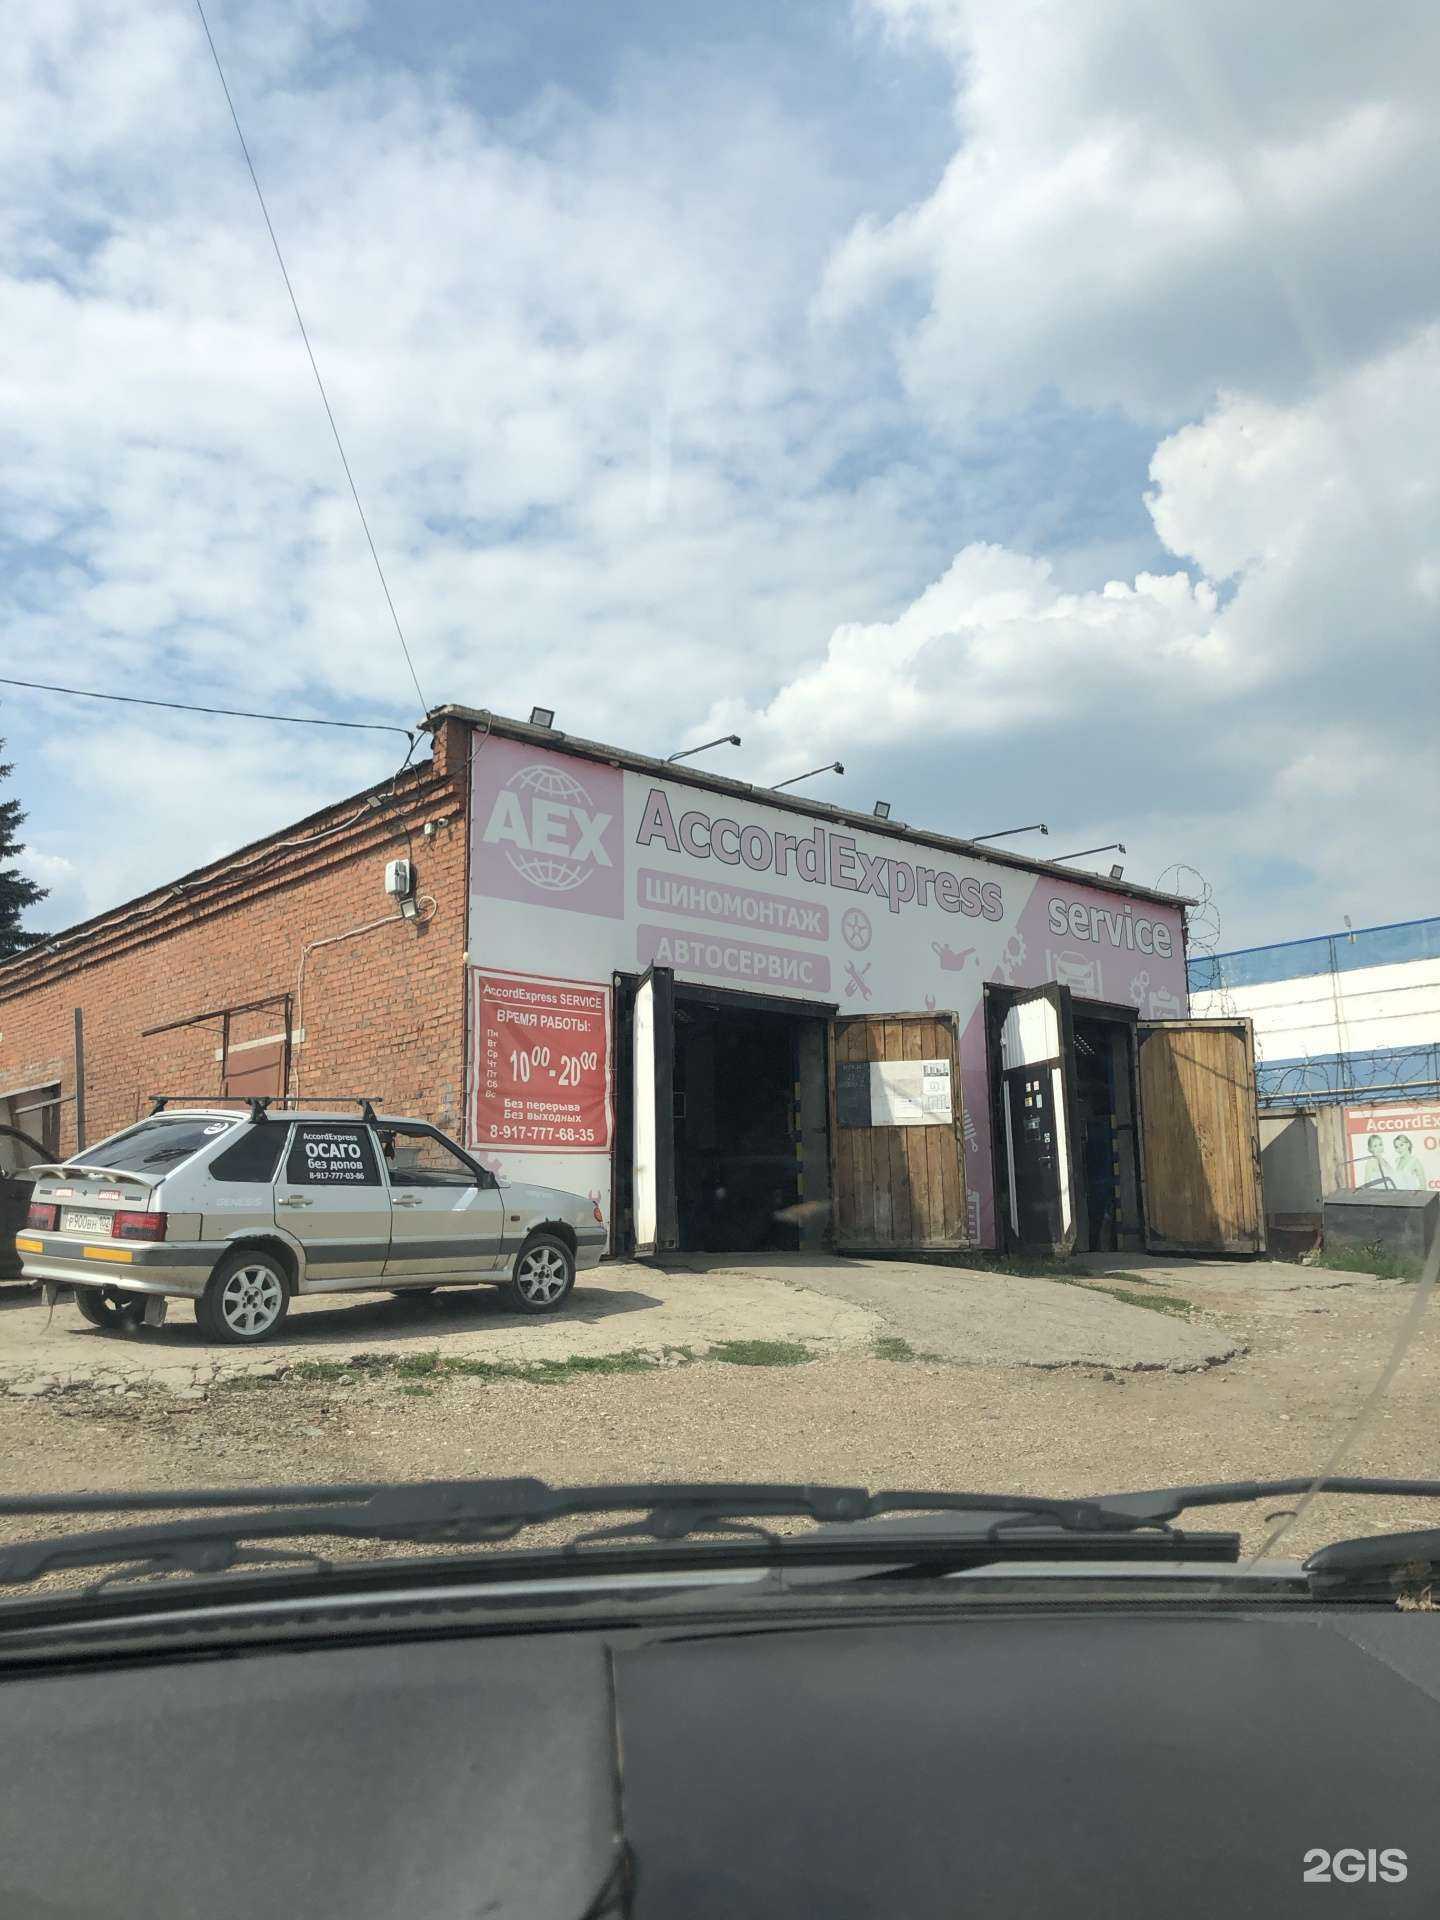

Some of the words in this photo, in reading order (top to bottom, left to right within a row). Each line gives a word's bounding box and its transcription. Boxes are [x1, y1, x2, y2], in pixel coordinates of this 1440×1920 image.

[482, 788, 614, 868] AEX
[636, 788, 1004, 923] AccordExpress
[645, 876, 824, 935] ШИНОМОНТАЖ
[1048, 896, 1174, 960] service
[656, 936, 815, 985] АВТОСЕРВИС
[482, 984, 558, 1004] AccordExpress
[559, 993, 603, 1009] SERVICE
[496, 1009, 538, 1027] ВРЕМЯ
[540, 1015, 592, 1032] РАБОТЫ:
[487, 1029, 499, 1037] Пн
[487, 1039, 497, 1048] Вт
[487, 1049, 499, 1059] Ср
[486, 1079, 498, 1088] Сб
[504, 1098, 524, 1109] Без
[526, 1100, 581, 1112] перерыва
[504, 1109, 524, 1121] Без
[527, 1112, 582, 1123] выходных
[303, 1132, 358, 1142] AccordExpress
[489, 1123, 595, 1142] 8-917-777-68-35
[305, 1142, 361, 1158] ОСАГО
[308, 1158, 328, 1169] без
[330, 1160, 363, 1171] допов
